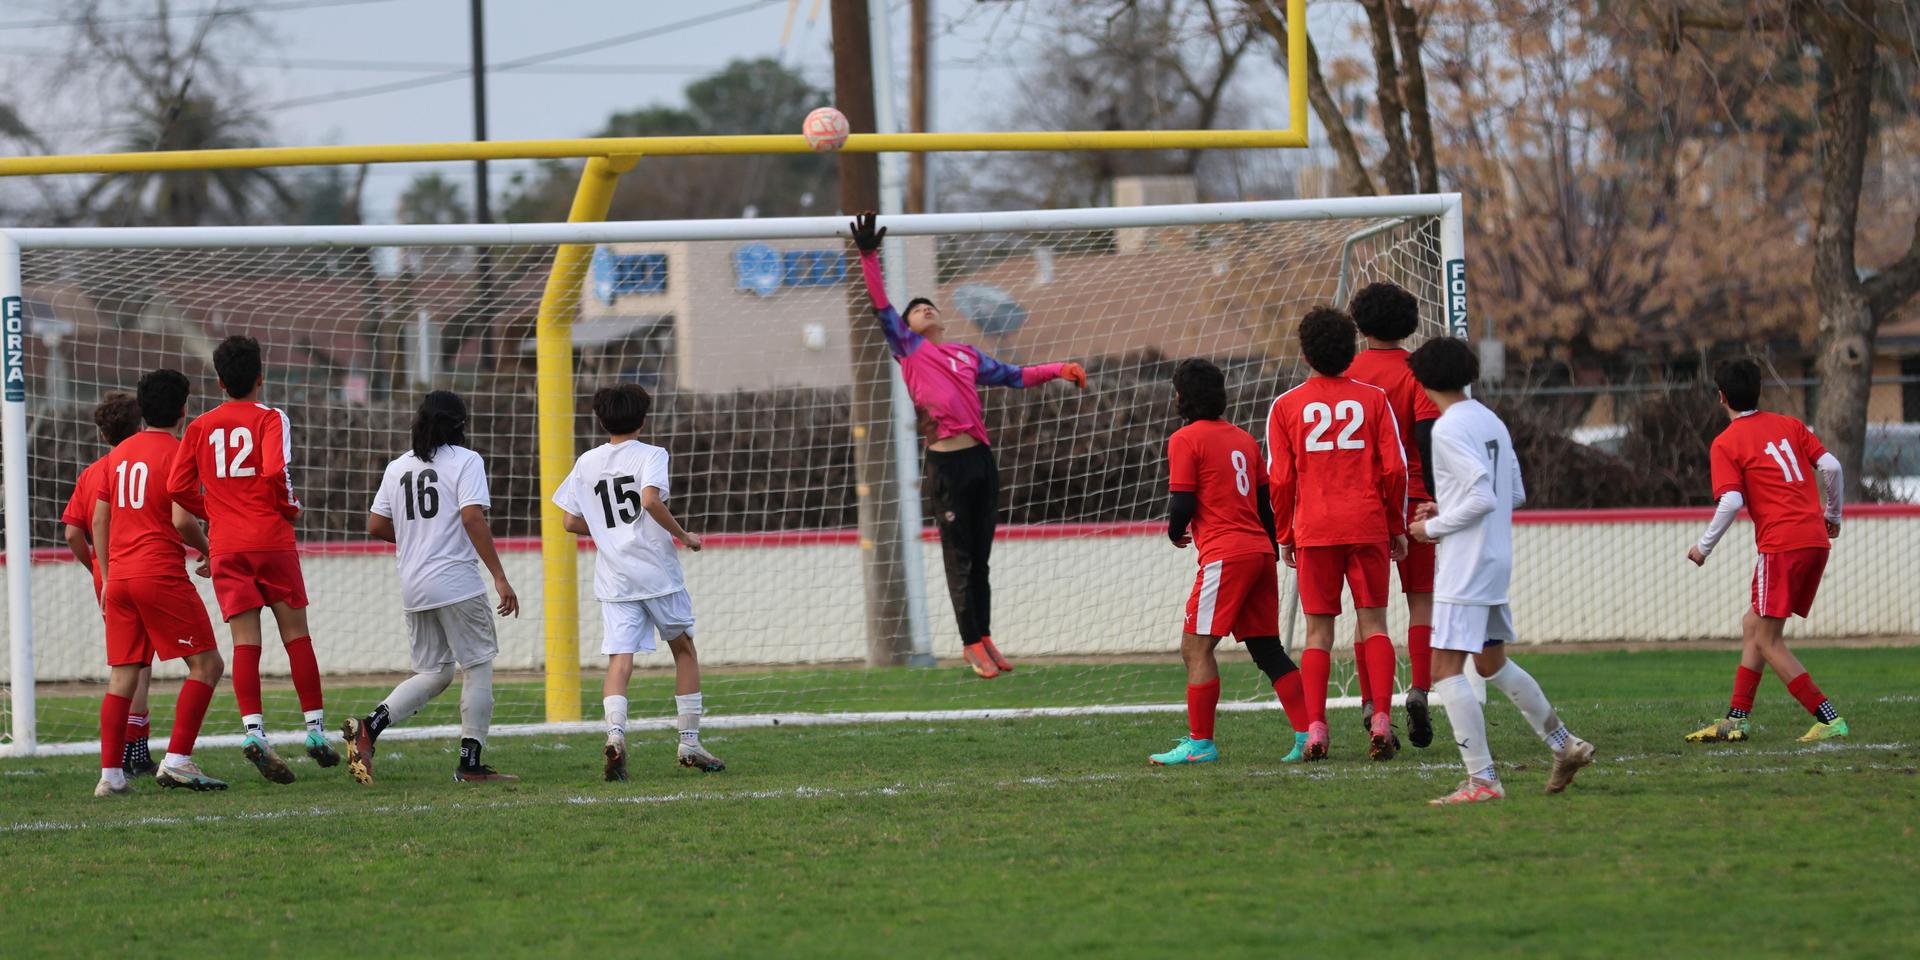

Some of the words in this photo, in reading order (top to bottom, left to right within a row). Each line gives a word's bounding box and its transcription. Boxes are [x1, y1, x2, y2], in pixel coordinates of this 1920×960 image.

[7, 301, 24, 383] FORZA
[209, 426, 256, 478] 12
[1303, 400, 1365, 452] 22
[116, 460, 148, 509] 10
[1231, 450, 1250, 496] 8
[1485, 439, 1499, 496] 7
[1764, 438, 1804, 482] 11
[400, 468, 439, 520] 16
[594, 475, 642, 528] 15
